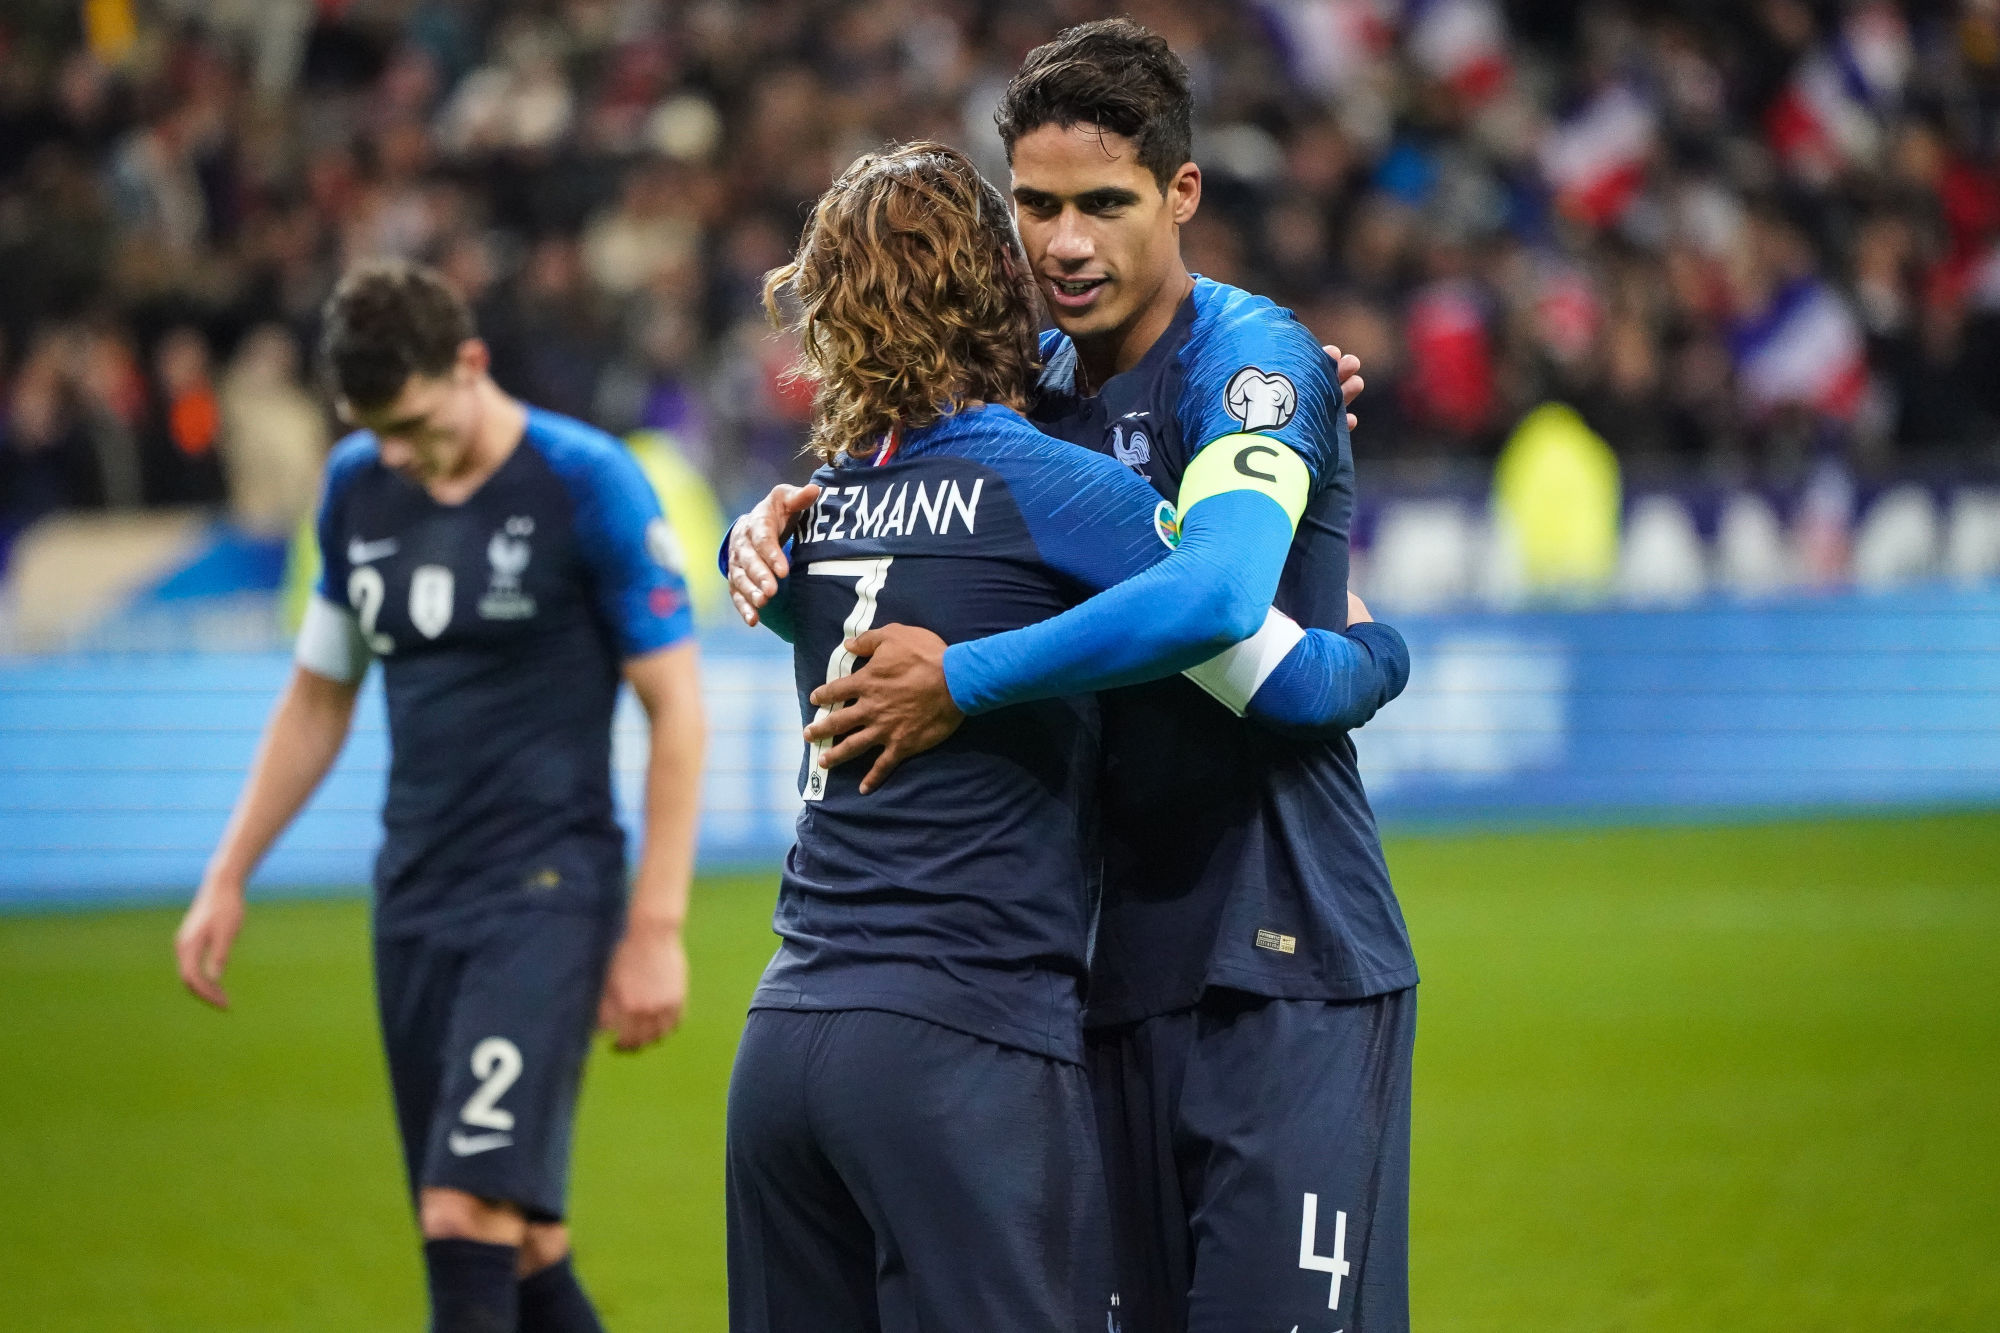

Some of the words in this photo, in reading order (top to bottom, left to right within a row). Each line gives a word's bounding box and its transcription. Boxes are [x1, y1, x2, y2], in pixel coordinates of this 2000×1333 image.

[1233, 445, 1280, 483] C
[798, 479, 984, 544] IEZMANN
[348, 565, 395, 655] 2
[803, 556, 893, 801] 7
[460, 1035, 523, 1130] 2
[1299, 1192, 1350, 1310] 4
